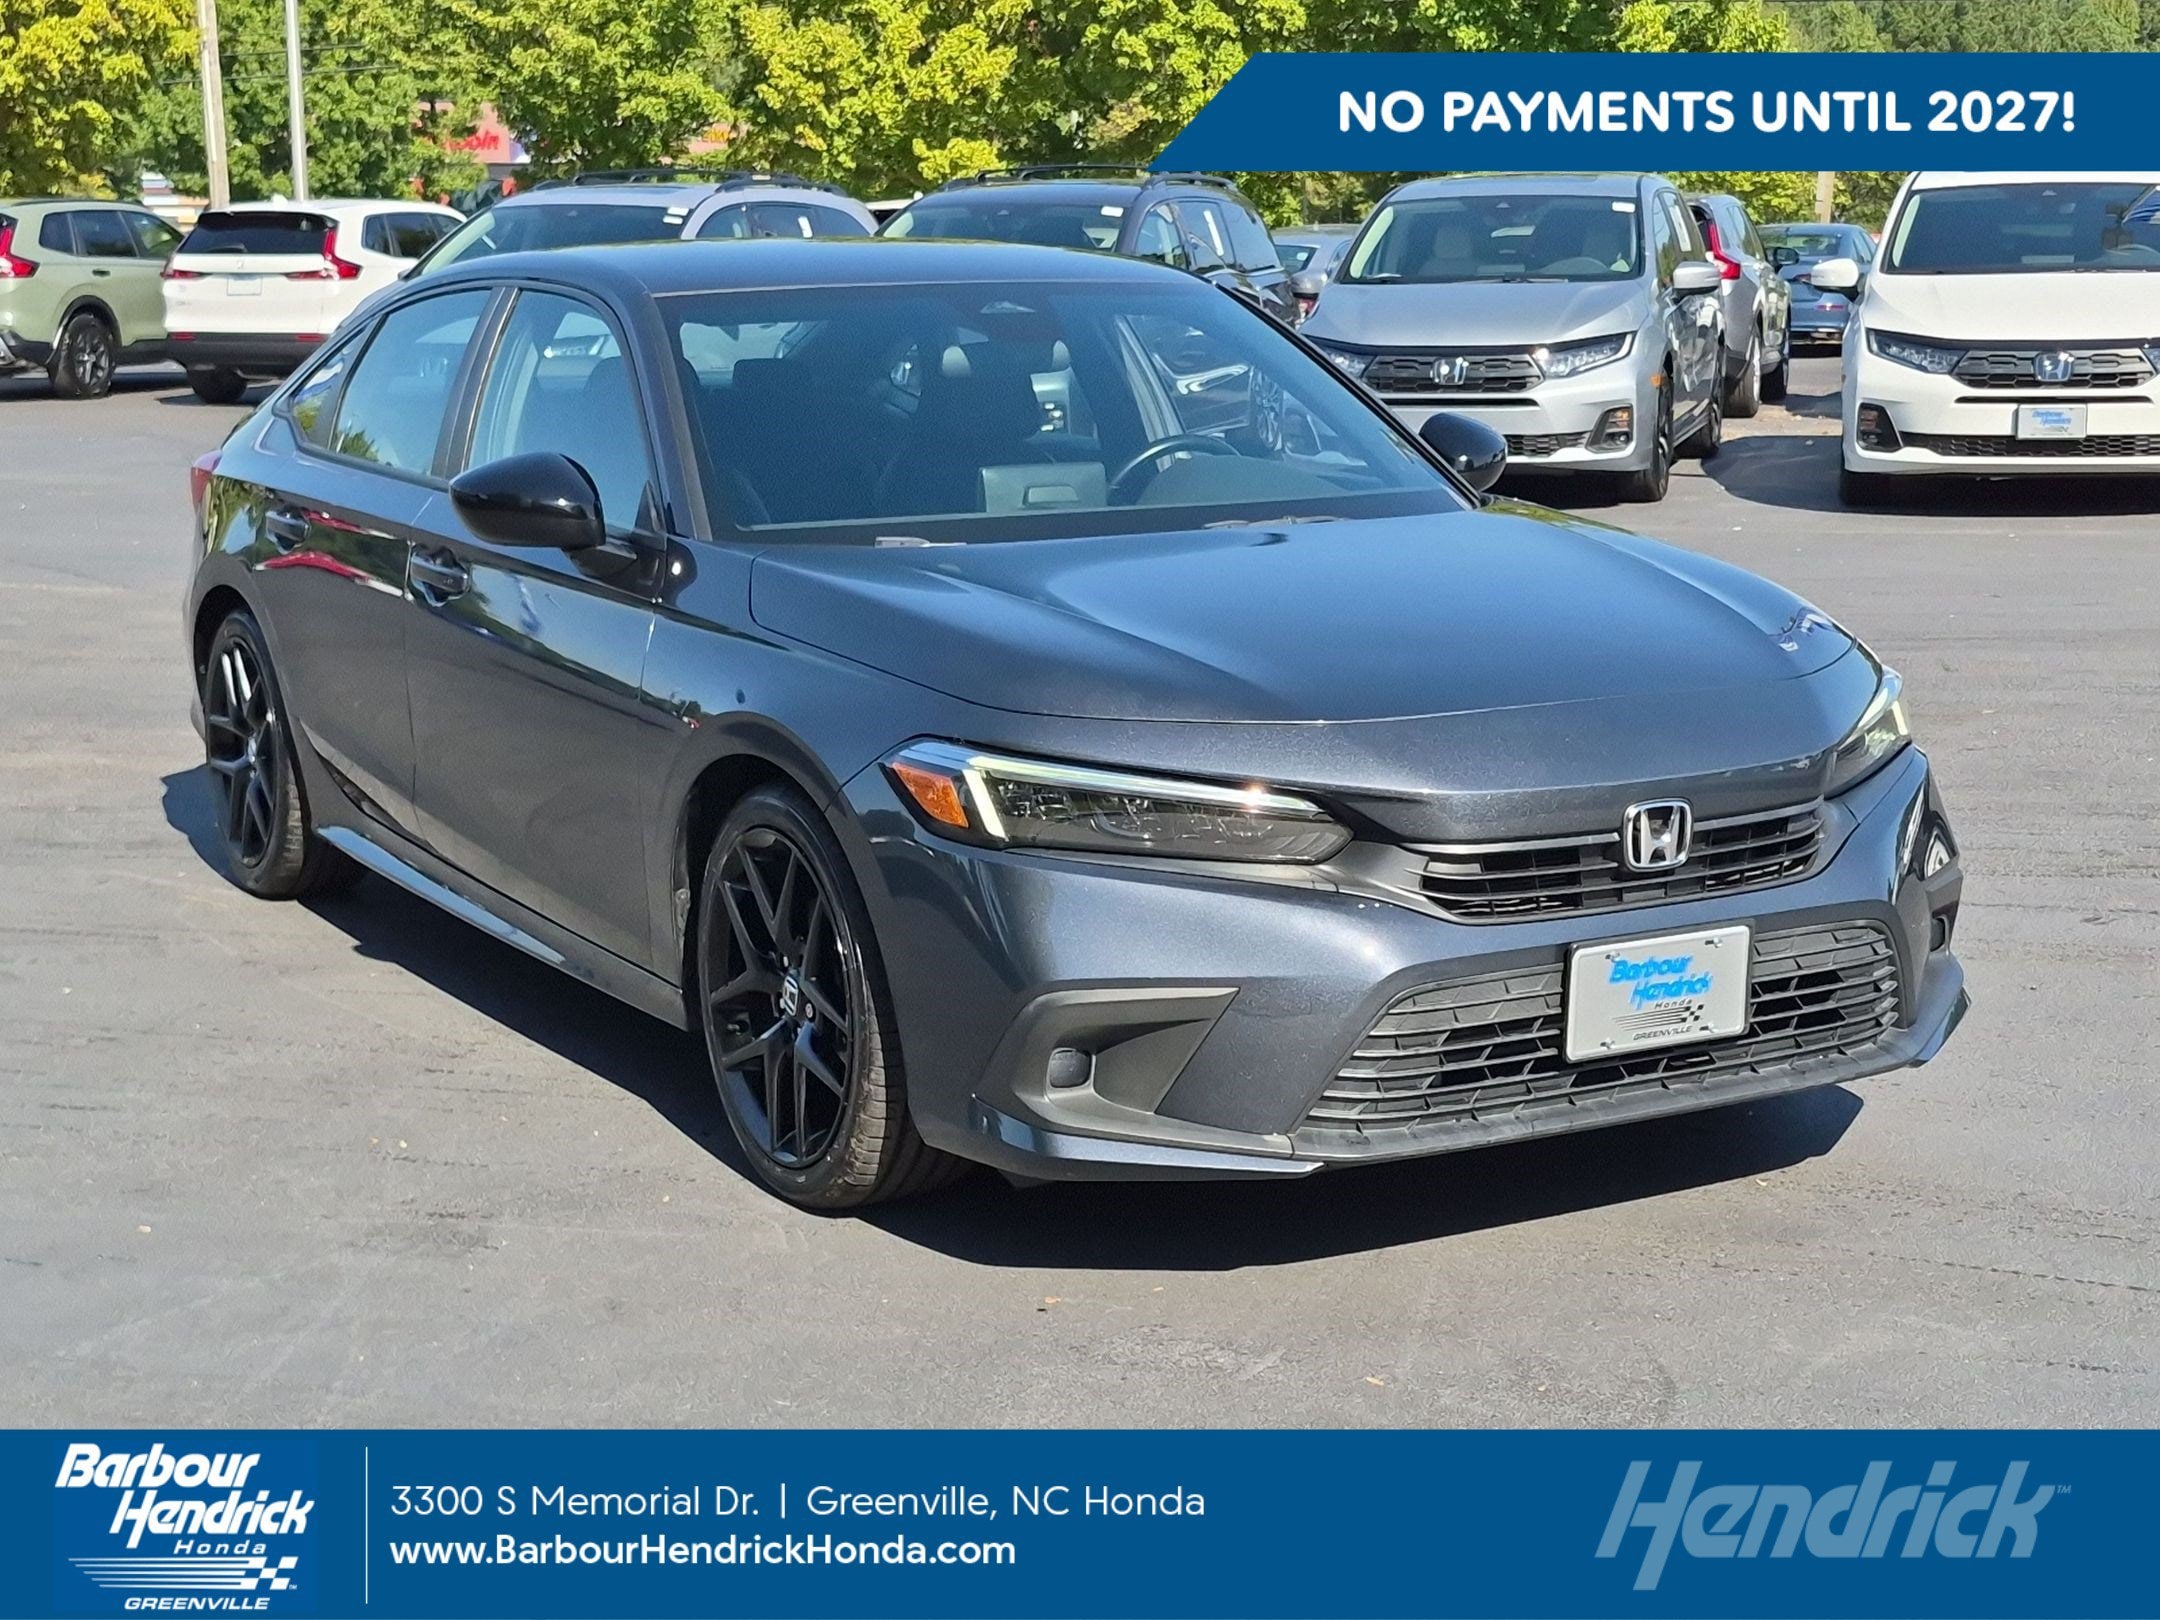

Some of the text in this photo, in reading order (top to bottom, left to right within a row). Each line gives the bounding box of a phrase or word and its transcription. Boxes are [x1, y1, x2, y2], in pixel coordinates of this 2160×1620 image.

[1609, 956, 1693, 983] Barbour
[1654, 998, 1692, 1010] Honda
[1632, 1025, 1692, 1041] GREENVILLE
